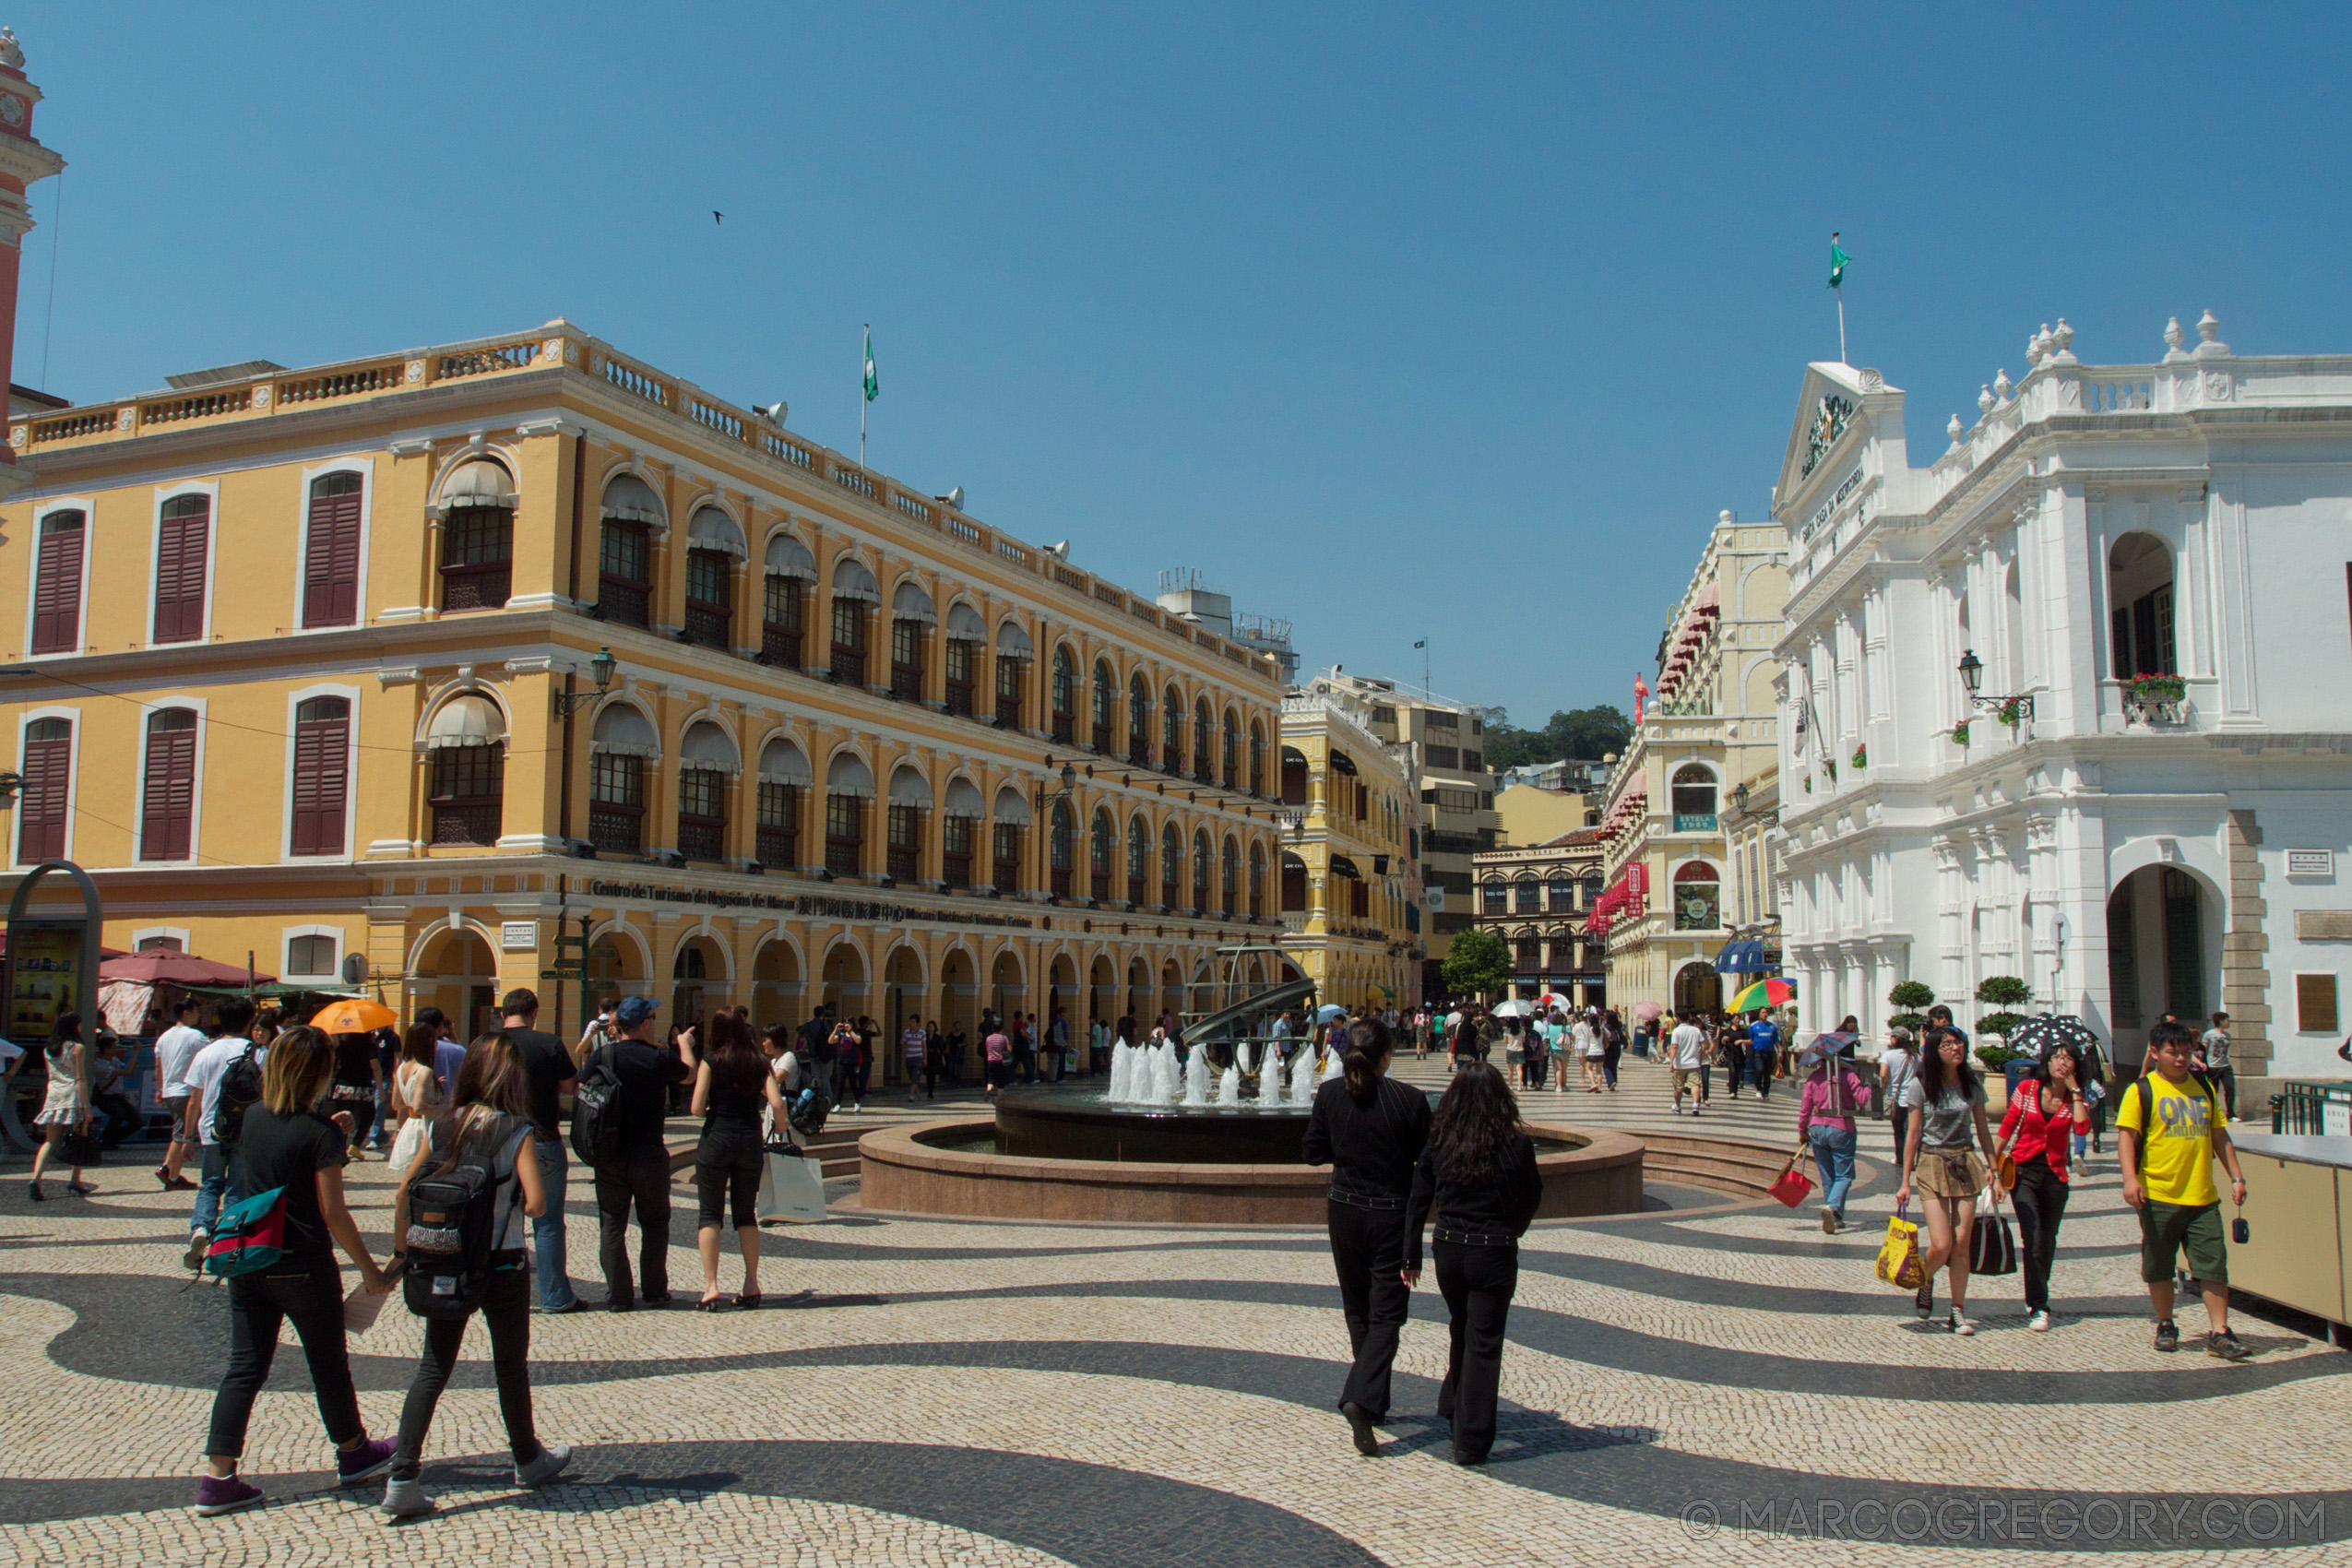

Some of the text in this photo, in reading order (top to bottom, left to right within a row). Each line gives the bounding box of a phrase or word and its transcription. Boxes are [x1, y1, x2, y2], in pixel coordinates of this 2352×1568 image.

[593, 881, 630, 897] Centro
[632, 883, 646, 898] de
[647, 885, 693, 903] Turismo
[695, 887, 707, 902] de
[752, 893, 765, 908] de
[937, 909, 973, 923] Business
[2158, 1096, 2210, 1125] ONE
